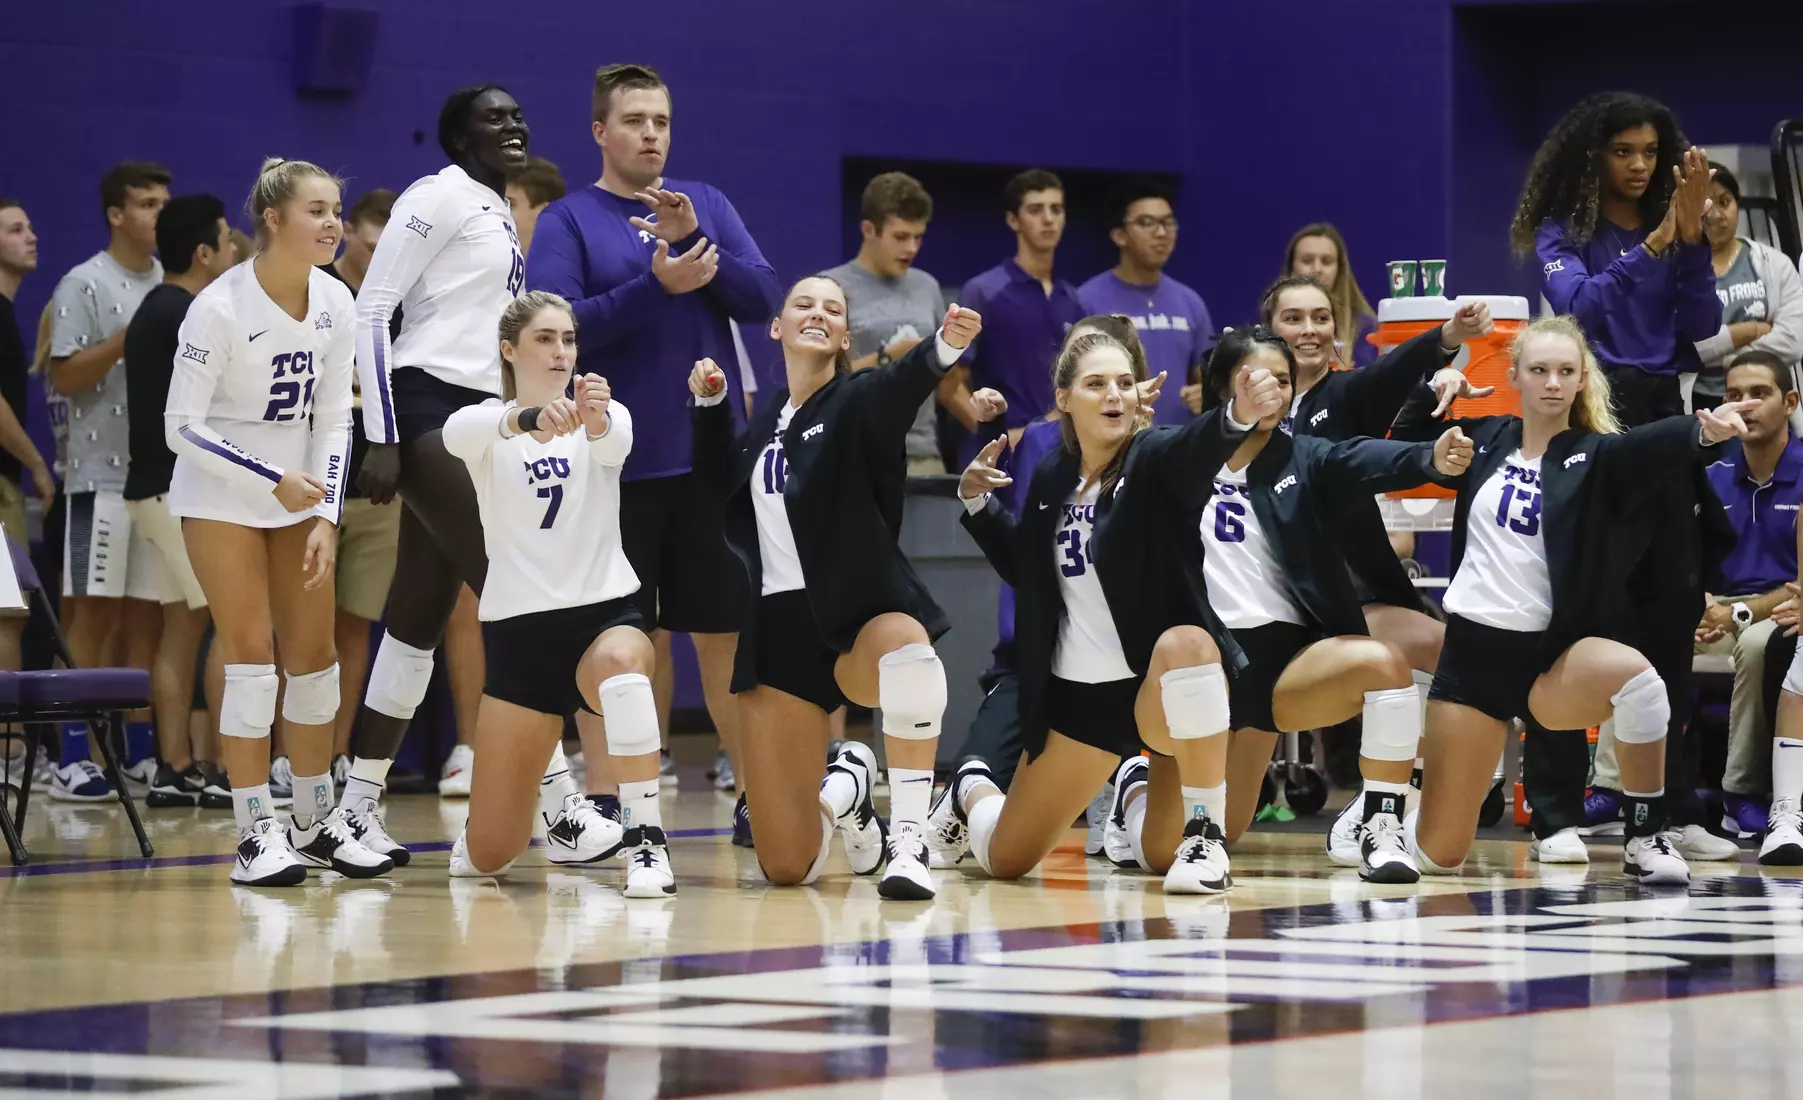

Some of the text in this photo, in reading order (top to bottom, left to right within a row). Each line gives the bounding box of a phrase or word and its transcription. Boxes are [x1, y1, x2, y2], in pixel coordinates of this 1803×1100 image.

[506, 247, 524, 299] 19
[1729, 279, 1766, 303] FROGS
[262, 377, 316, 422] 21
[1310, 408, 1329, 427] TCU
[802, 423, 824, 441] TCU
[327, 454, 341, 480] BAH
[1563, 452, 1587, 469] TCU
[1273, 474, 1298, 495] TCU
[536, 484, 564, 529] 7
[1496, 484, 1542, 536] 13
[1215, 501, 1245, 543] 6
